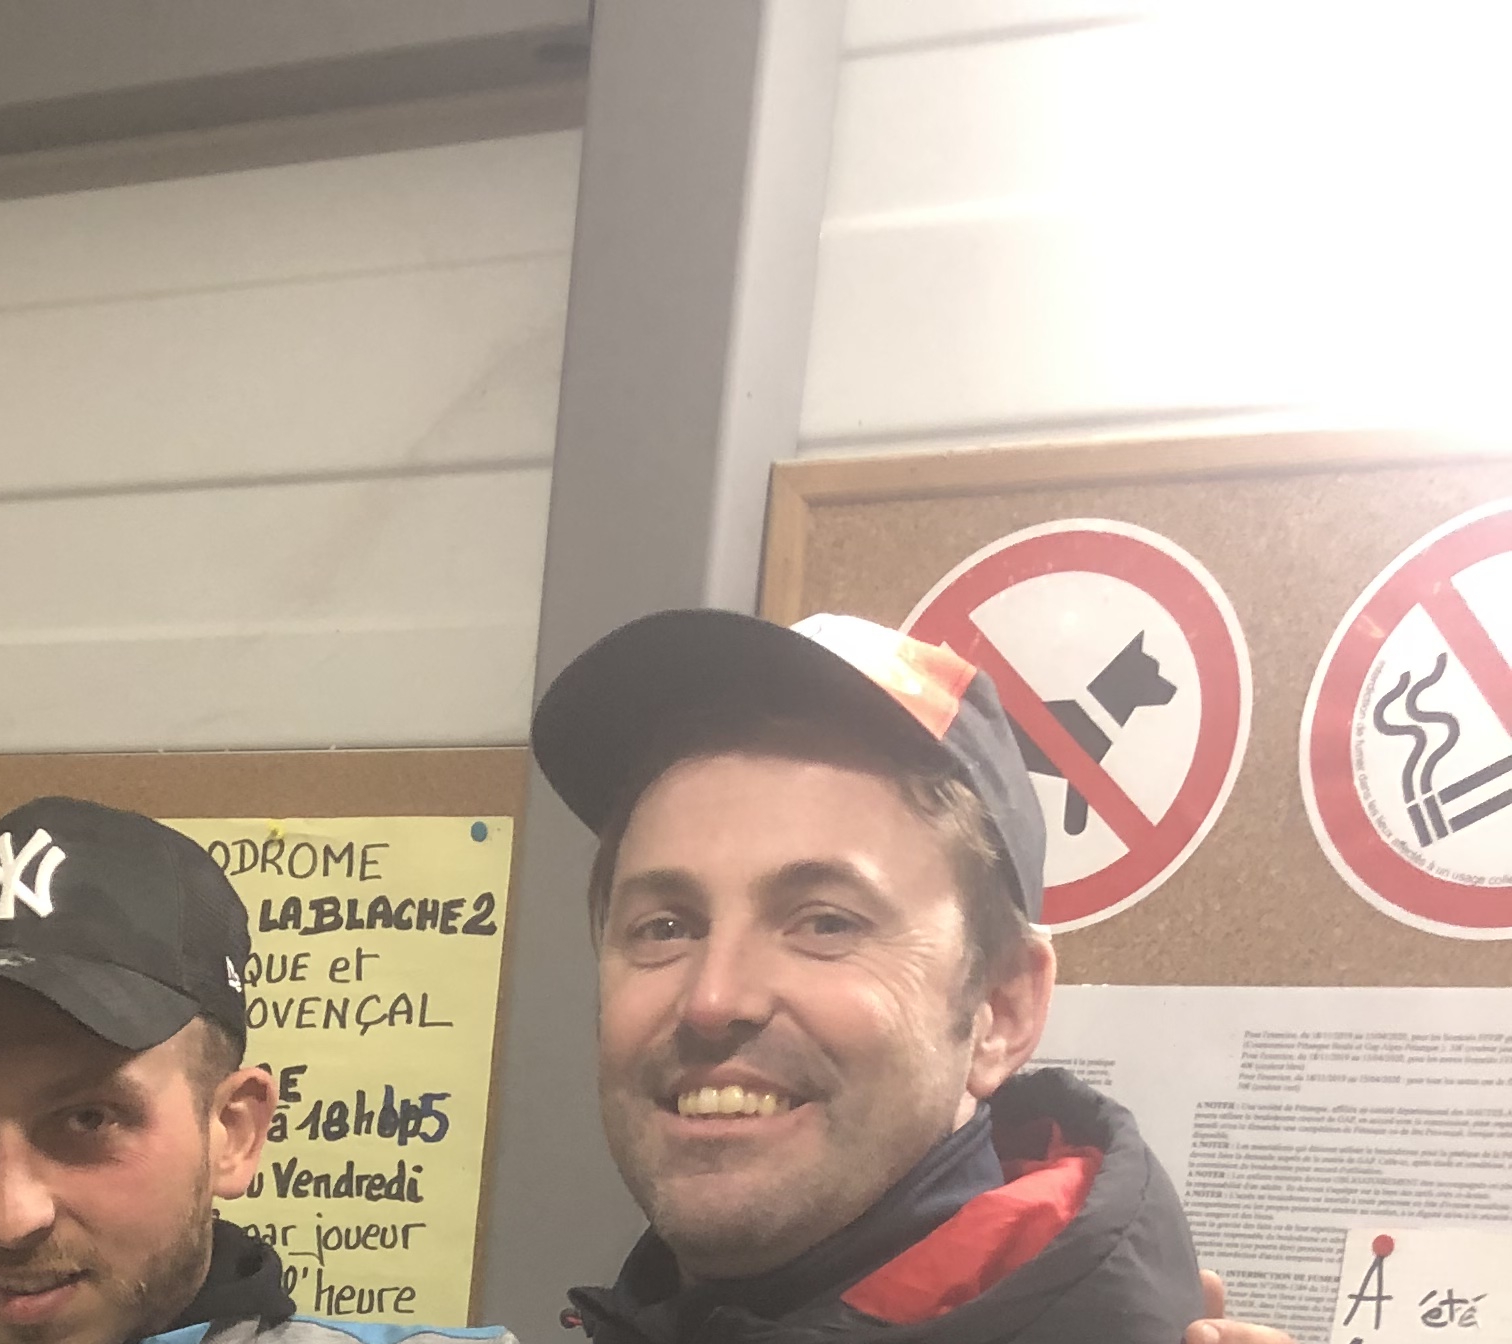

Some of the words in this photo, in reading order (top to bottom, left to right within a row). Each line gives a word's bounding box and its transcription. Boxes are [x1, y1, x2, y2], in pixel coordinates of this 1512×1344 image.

[328, 946, 381, 984] et
[272, 1156, 425, 1204] Vendredi
[288, 1212, 427, 1267] joueur
